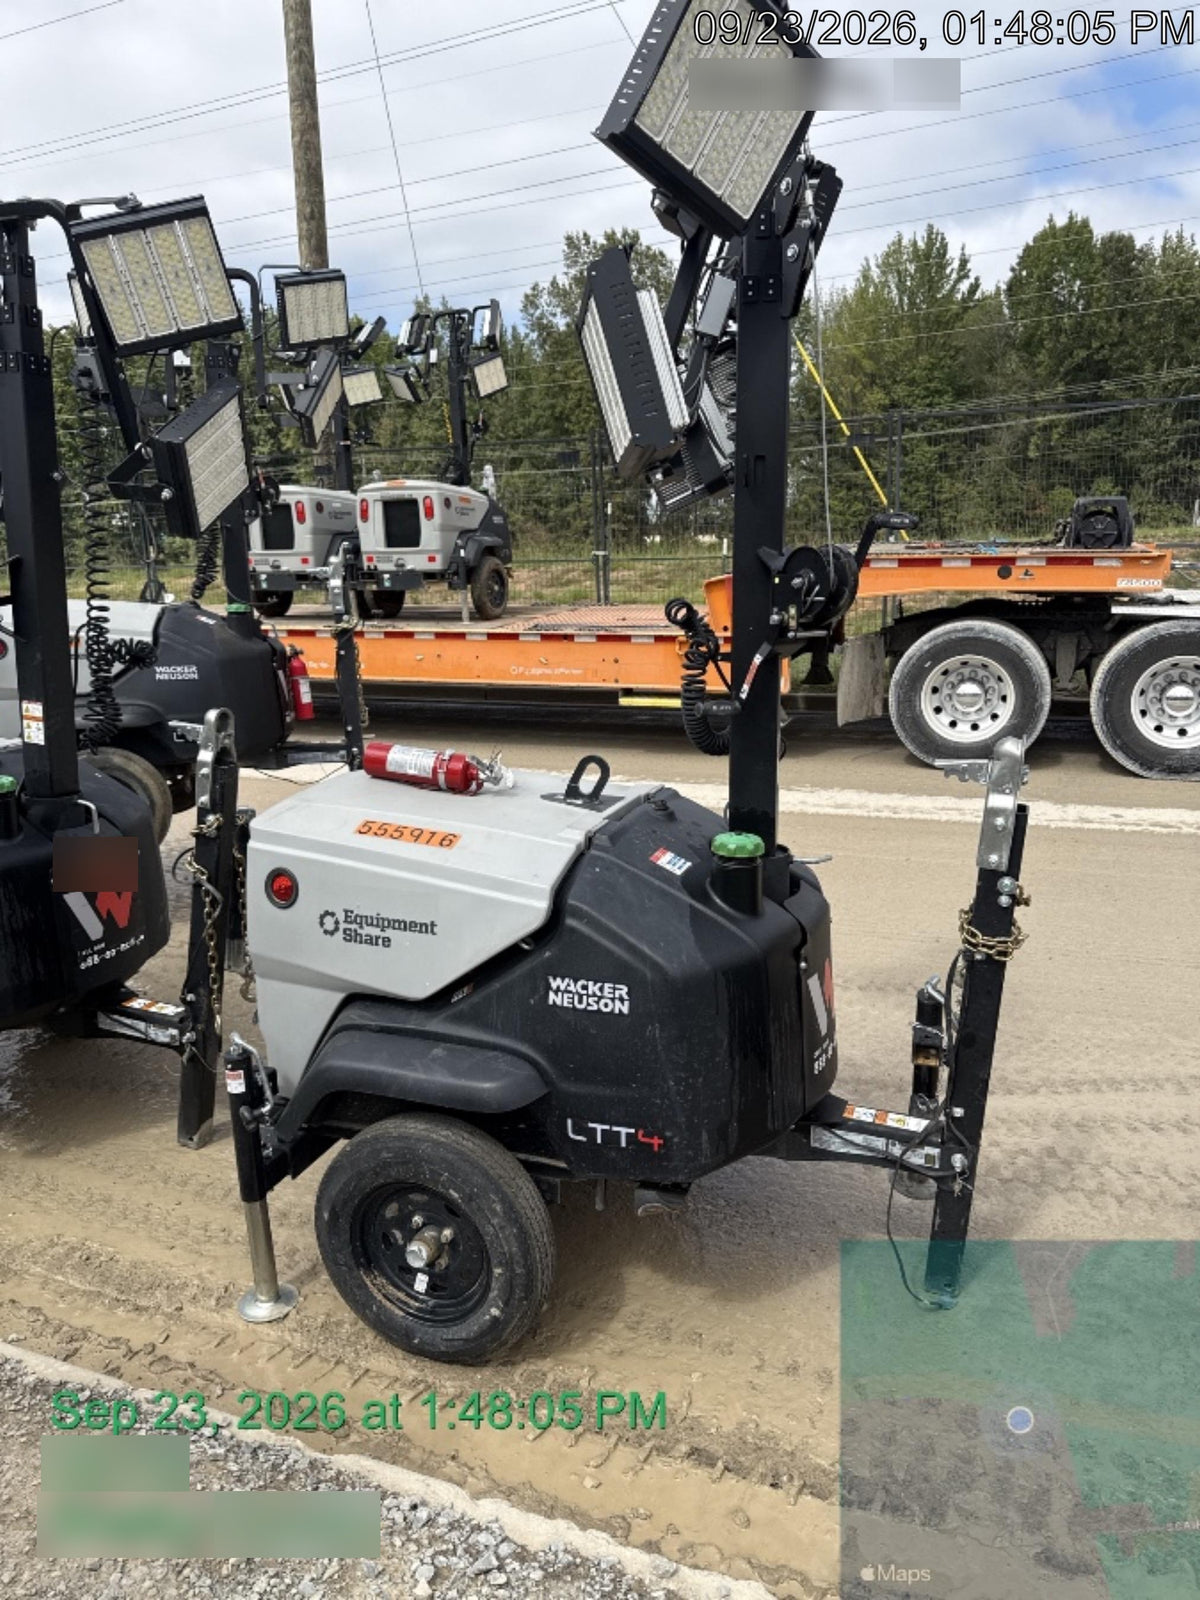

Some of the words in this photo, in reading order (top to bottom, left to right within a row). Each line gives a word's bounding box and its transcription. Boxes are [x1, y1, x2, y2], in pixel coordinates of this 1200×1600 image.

[357, 820, 459, 848] 555916
[342, 909, 438, 935] Equipment
[342, 928, 392, 948] Share
[548, 976, 630, 999] WACKER
[548, 990, 630, 1015] NEUSON
[566, 1118, 664, 1152] LTT4
